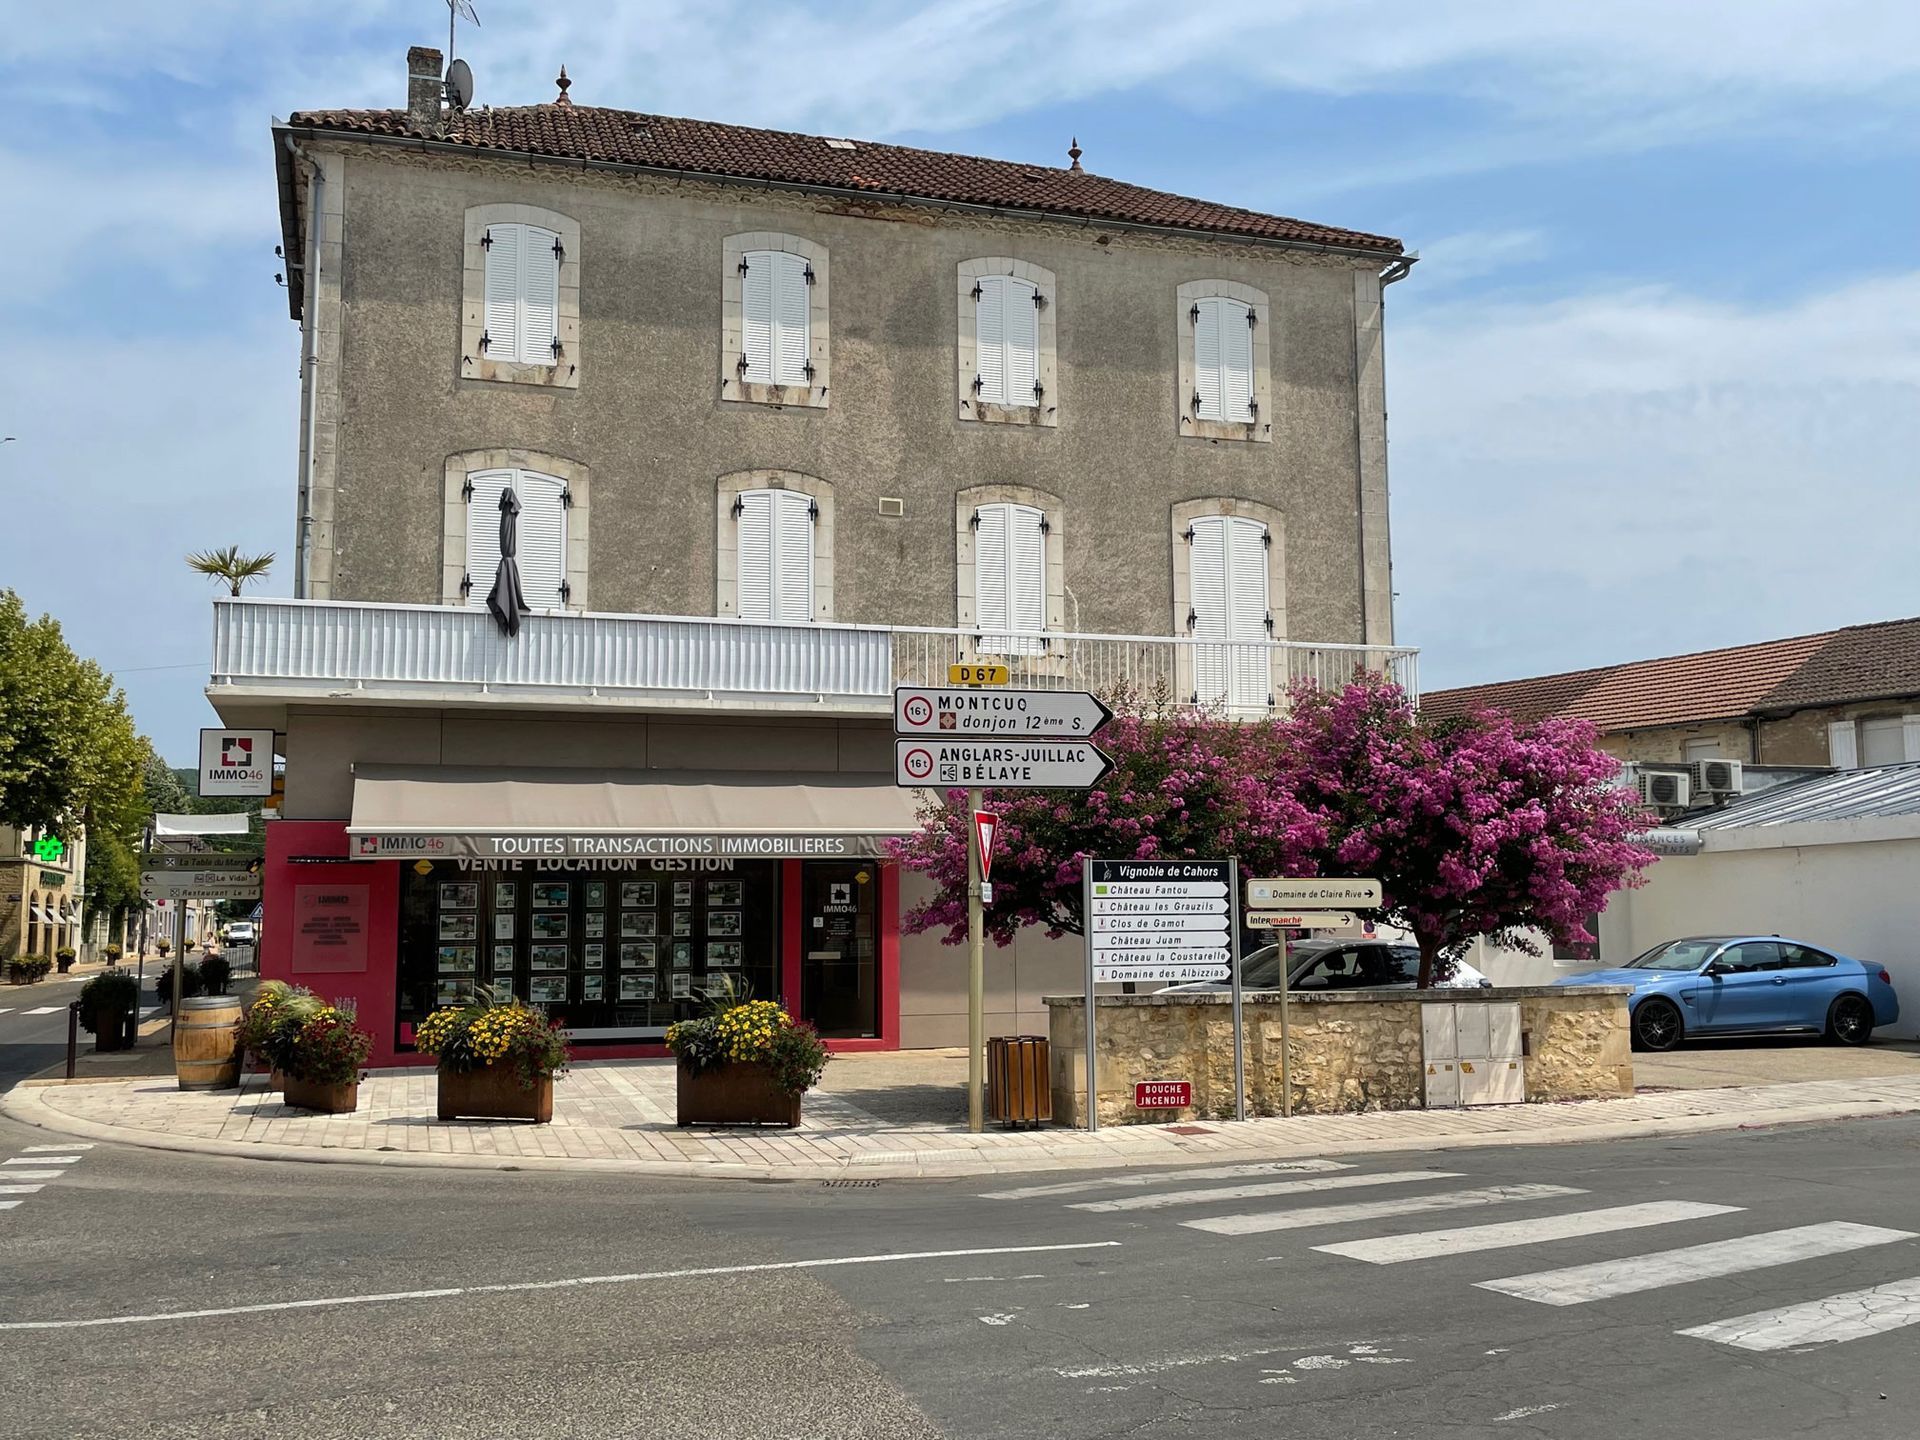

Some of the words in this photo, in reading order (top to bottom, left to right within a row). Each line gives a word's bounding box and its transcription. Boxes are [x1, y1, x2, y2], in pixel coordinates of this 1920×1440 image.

[960, 668, 970, 681] D
[976, 668, 997, 681] 67
[938, 696, 1027, 712] MONTCUQ
[910, 706, 921, 716] 16
[923, 707, 928, 716] t
[962, 715, 1017, 732] donjon
[1026, 716, 1064, 730] 12ème
[1072, 717, 1085, 730] S.
[939, 748, 1085, 762] ANGLARS-JUILLAC
[910, 759, 922, 768] 16
[923, 760, 928, 768] t
[209, 769, 264, 780] IMMO46
[963, 764, 1031, 780] BÉLAYE
[381, 837, 445, 850] IMMO46
[491, 837, 565, 854] TOUTES
[572, 837, 713, 854] TRANSACTIONS
[721, 837, 845, 854] IMMOBILIERES
[457, 858, 523, 871] VENTE
[537, 858, 637, 871] LOCATION
[650, 858, 734, 871] GESTION
[1120, 865, 1165, 879] Vignoble
[1167, 865, 1180, 876] de
[1183, 865, 1219, 877] Cahors
[1110, 885, 1151, 895] Château
[1155, 885, 1188, 894] Fantou
[1272, 889, 1306, 899] Domaine
[1308, 889, 1318, 899] de
[1320, 889, 1344, 899] Claire
[1345, 889, 1362, 899] Rive
[823, 905, 857, 913] IMMO46
[1110, 902, 1150, 912] Château
[1154, 901, 1169, 911] les
[1174, 902, 1214, 911] Grauzils
[1110, 919, 1132, 929] Clos
[1137, 919, 1148, 928] de
[1153, 919, 1185, 928] Gamot
[1250, 915, 1302, 925] Intermarché
[1110, 936, 1151, 946] Château
[1156, 936, 1182, 945] Juam
[1111, 952, 1151, 962] Château
[1156, 952, 1165, 961] la
[1170, 951, 1226, 961] Coustarelle
[1111, 969, 1153, 979] Domaine
[1159, 969, 1175, 978] des
[1181, 967, 1225, 978] Albizzias
[1145, 1084, 1182, 1094] BOUCHE
[1138, 1096, 1186, 1105] INCENDIE
